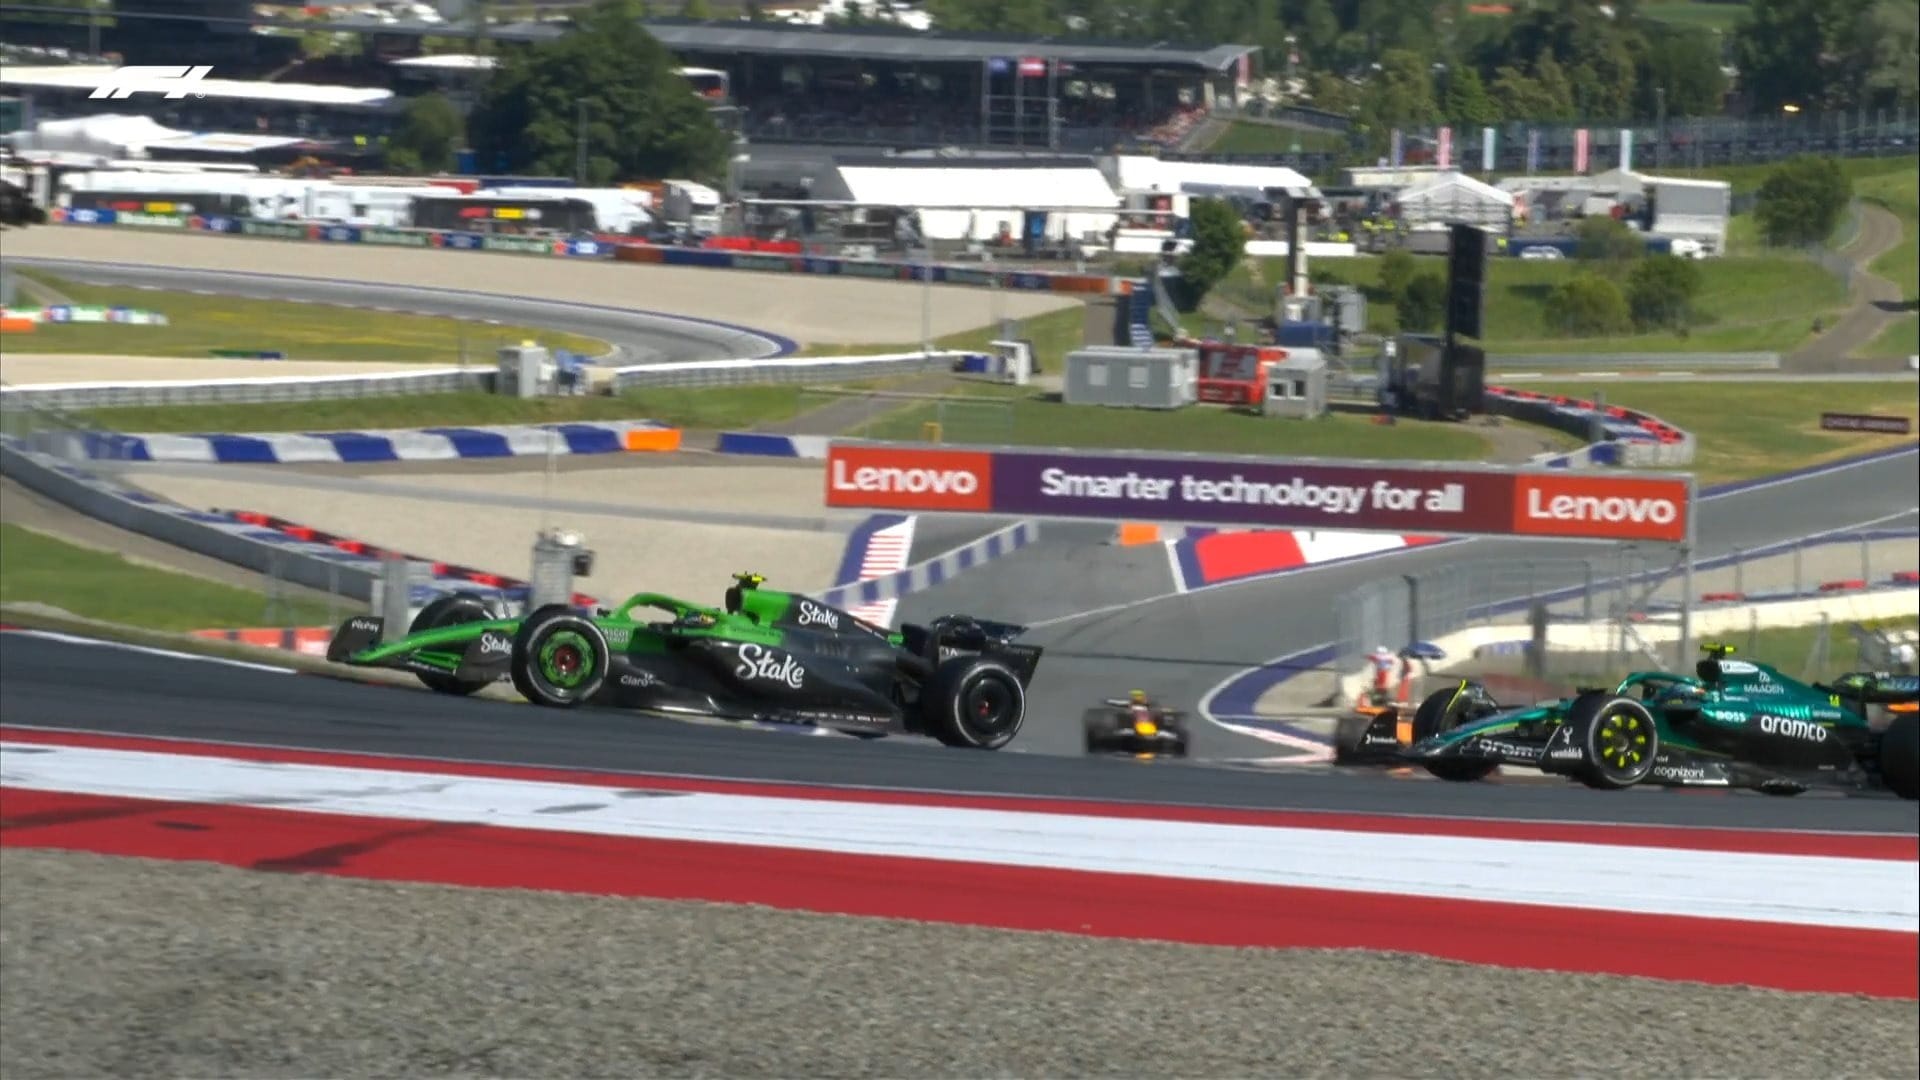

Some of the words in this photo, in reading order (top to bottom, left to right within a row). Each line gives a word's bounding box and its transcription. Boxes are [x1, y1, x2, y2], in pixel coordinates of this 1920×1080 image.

[832, 459, 978, 494] Lenovo
[1040, 467, 1174, 501] Smarter
[1181, 474, 1366, 513] technology
[1371, 480, 1421, 510] for
[1424, 483, 1464, 512] all
[1528, 488, 1677, 524] Lenovo
[798, 600, 839, 630] Stake
[735, 643, 805, 689] Stake
[1760, 714, 1827, 742] aramco
[1654, 766, 1704, 780] cognizant
